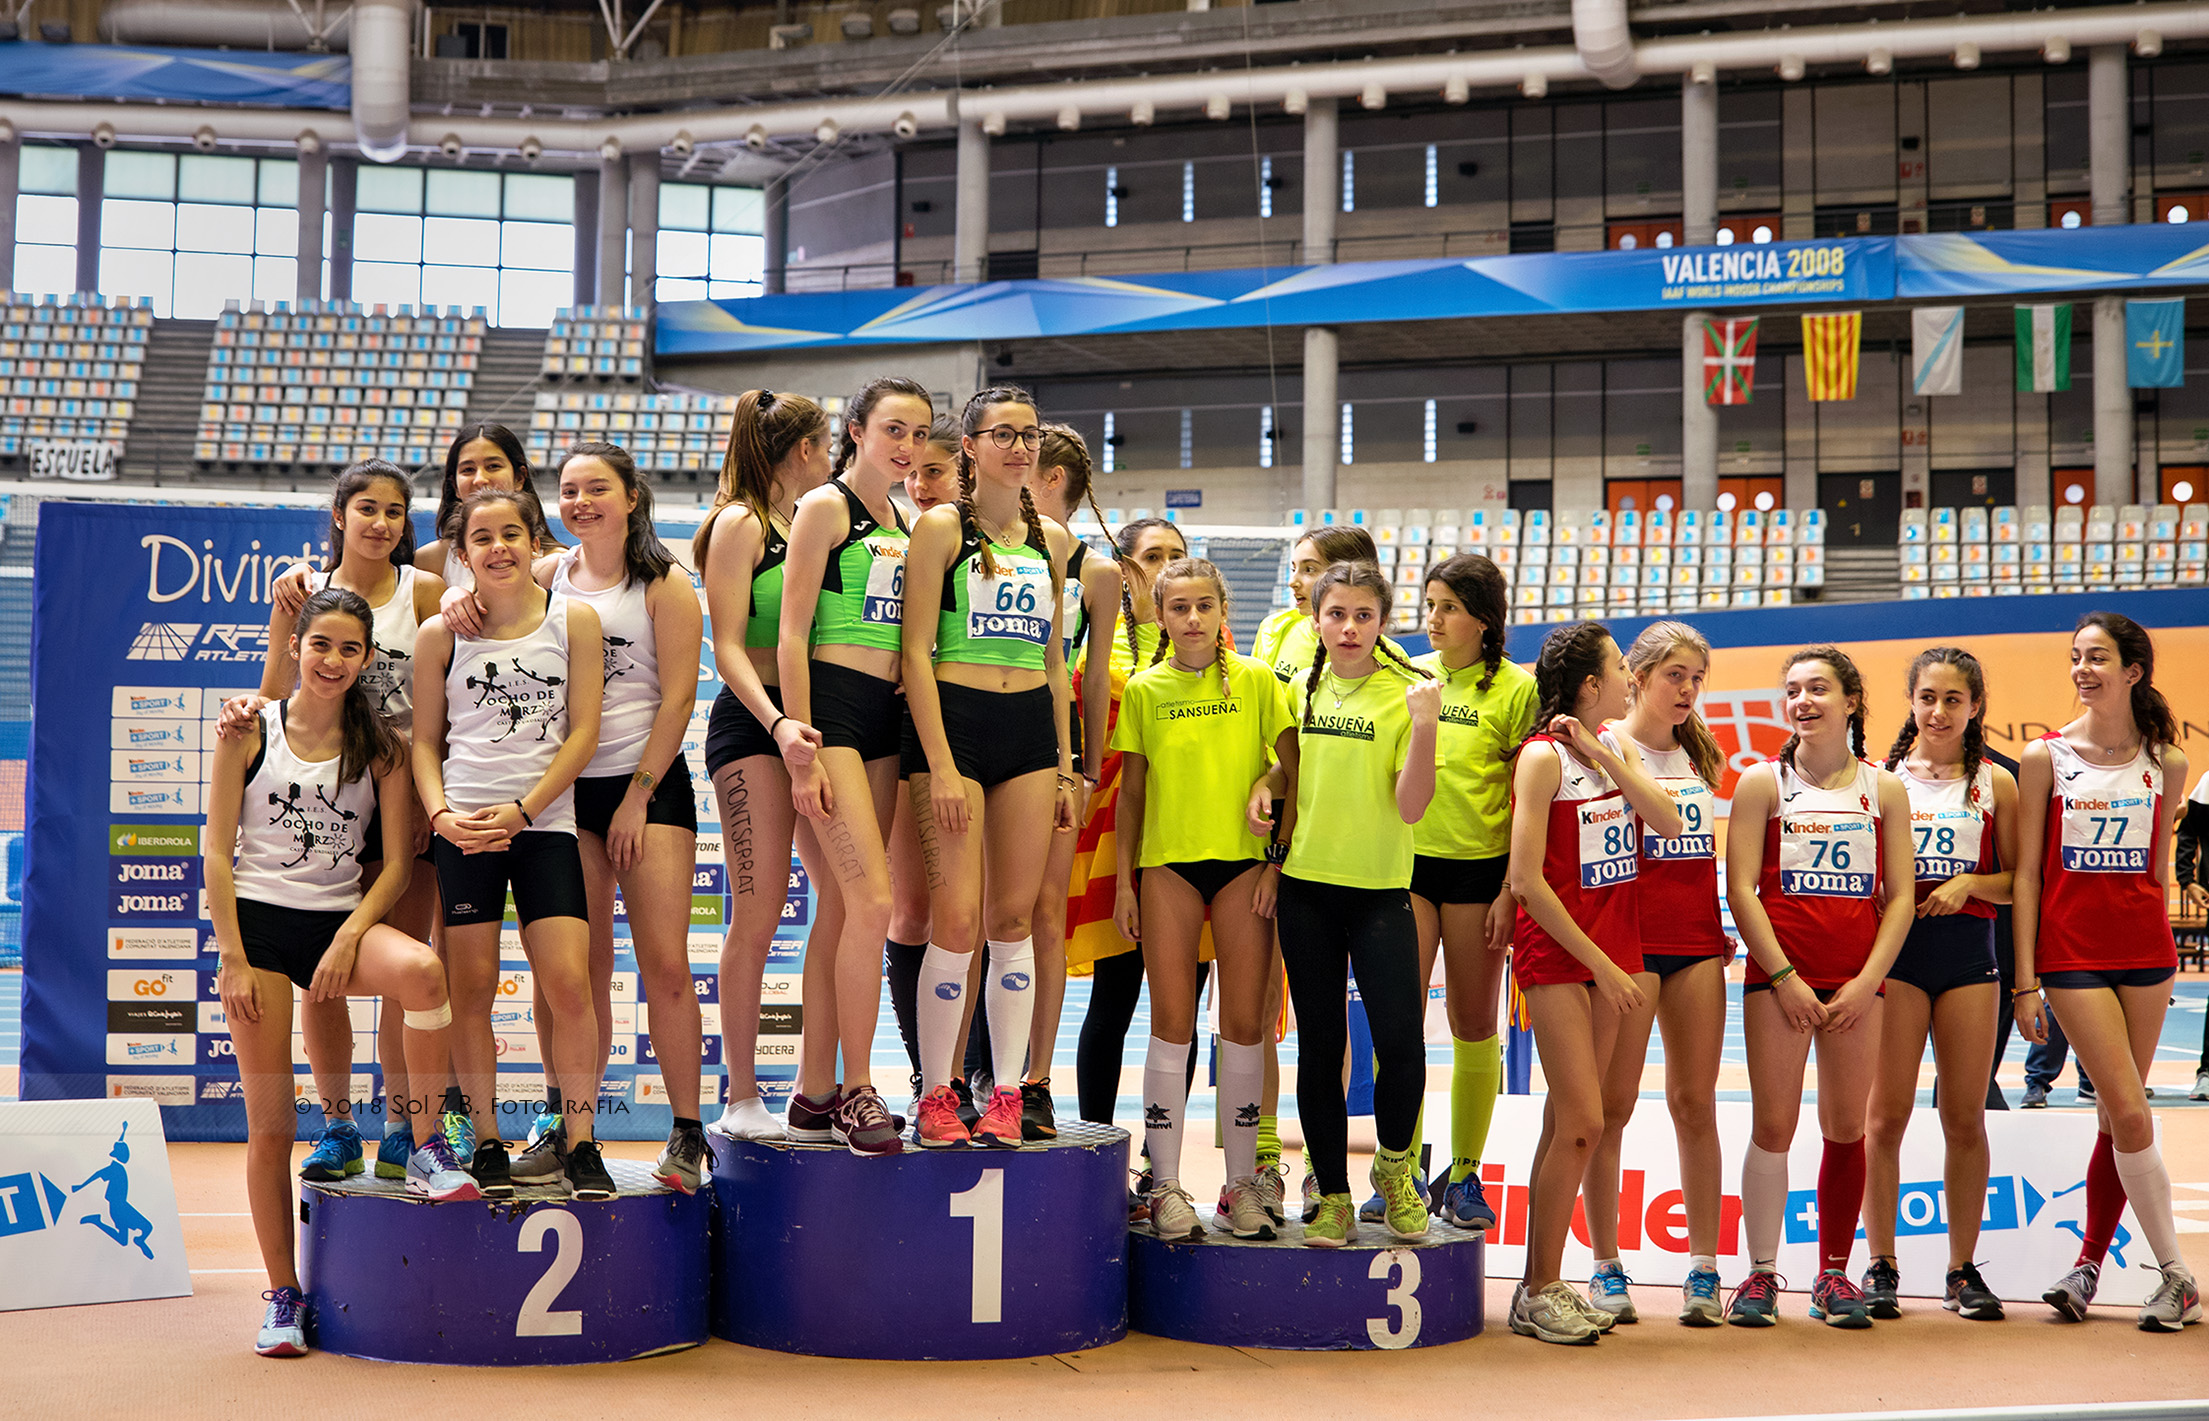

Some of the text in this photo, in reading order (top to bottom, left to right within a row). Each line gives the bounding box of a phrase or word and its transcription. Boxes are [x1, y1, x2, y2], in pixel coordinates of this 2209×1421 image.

[1662, 247, 1844, 284] VALENCIA 2008
[1687, 284, 1721, 298] WORLD
[1724, 282, 1760, 297] INDOOR
[1762, 279, 1844, 295] CHAMPIONSHIPS
[32, 448, 114, 474] ESCUELA
[995, 581, 1036, 613] 66
[972, 616, 1042, 639] Joma
[377, 661, 395, 671] DE
[487, 690, 555, 706] OCHO DE
[1169, 702, 1238, 720] SANSUEÑA
[1307, 716, 1376, 735] ANSUEÑA
[282, 819, 348, 833] OCHO DE
[2090, 817, 2129, 845] 77
[138, 837, 192, 846] IBERDROLA
[1604, 822, 1636, 856] 80
[1914, 827, 1956, 855] 78
[1809, 840, 1851, 870] 76
[2069, 849, 2144, 869] Joma
[118, 864, 185, 882] Joma
[1790, 871, 1864, 893] Joma
[117, 895, 184, 913] Joma
[133, 973, 173, 996] GO fit
[514, 974, 525, 983] fit
[950, 1168, 1004, 1323] 1
[516, 1208, 584, 1337] 2
[1366, 1250, 1422, 1350] 3
